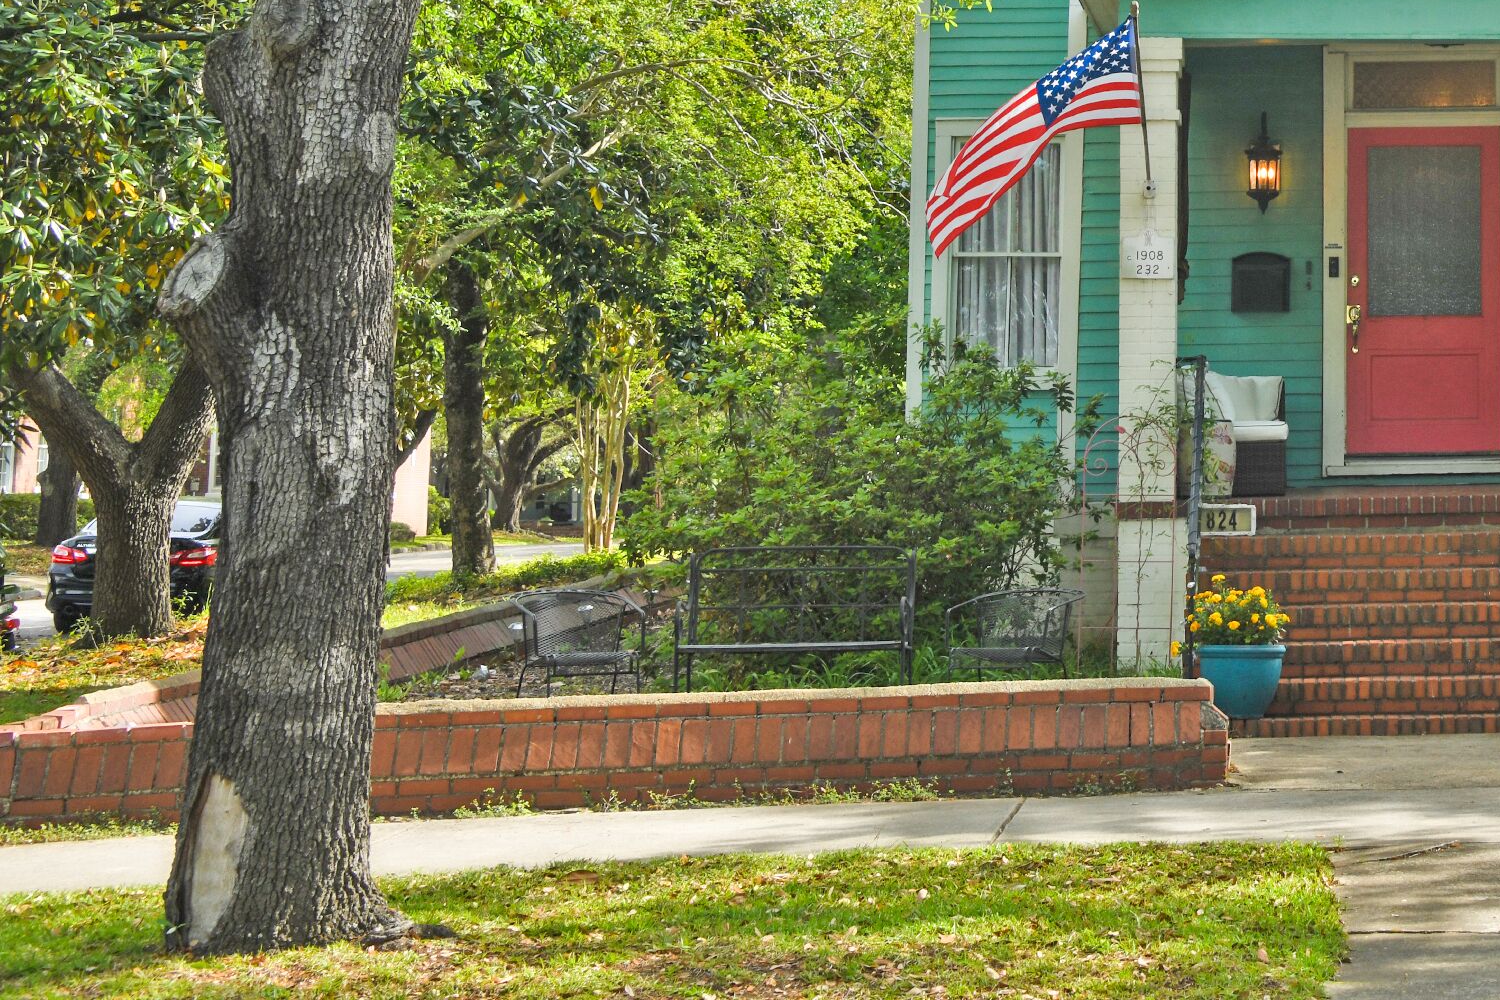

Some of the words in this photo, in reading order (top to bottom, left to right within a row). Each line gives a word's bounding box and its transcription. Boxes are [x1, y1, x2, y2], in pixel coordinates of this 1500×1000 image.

[1136, 250, 1164, 261] 1908
[1136, 264, 1159, 275] 232
[1206, 509, 1237, 531] 824
